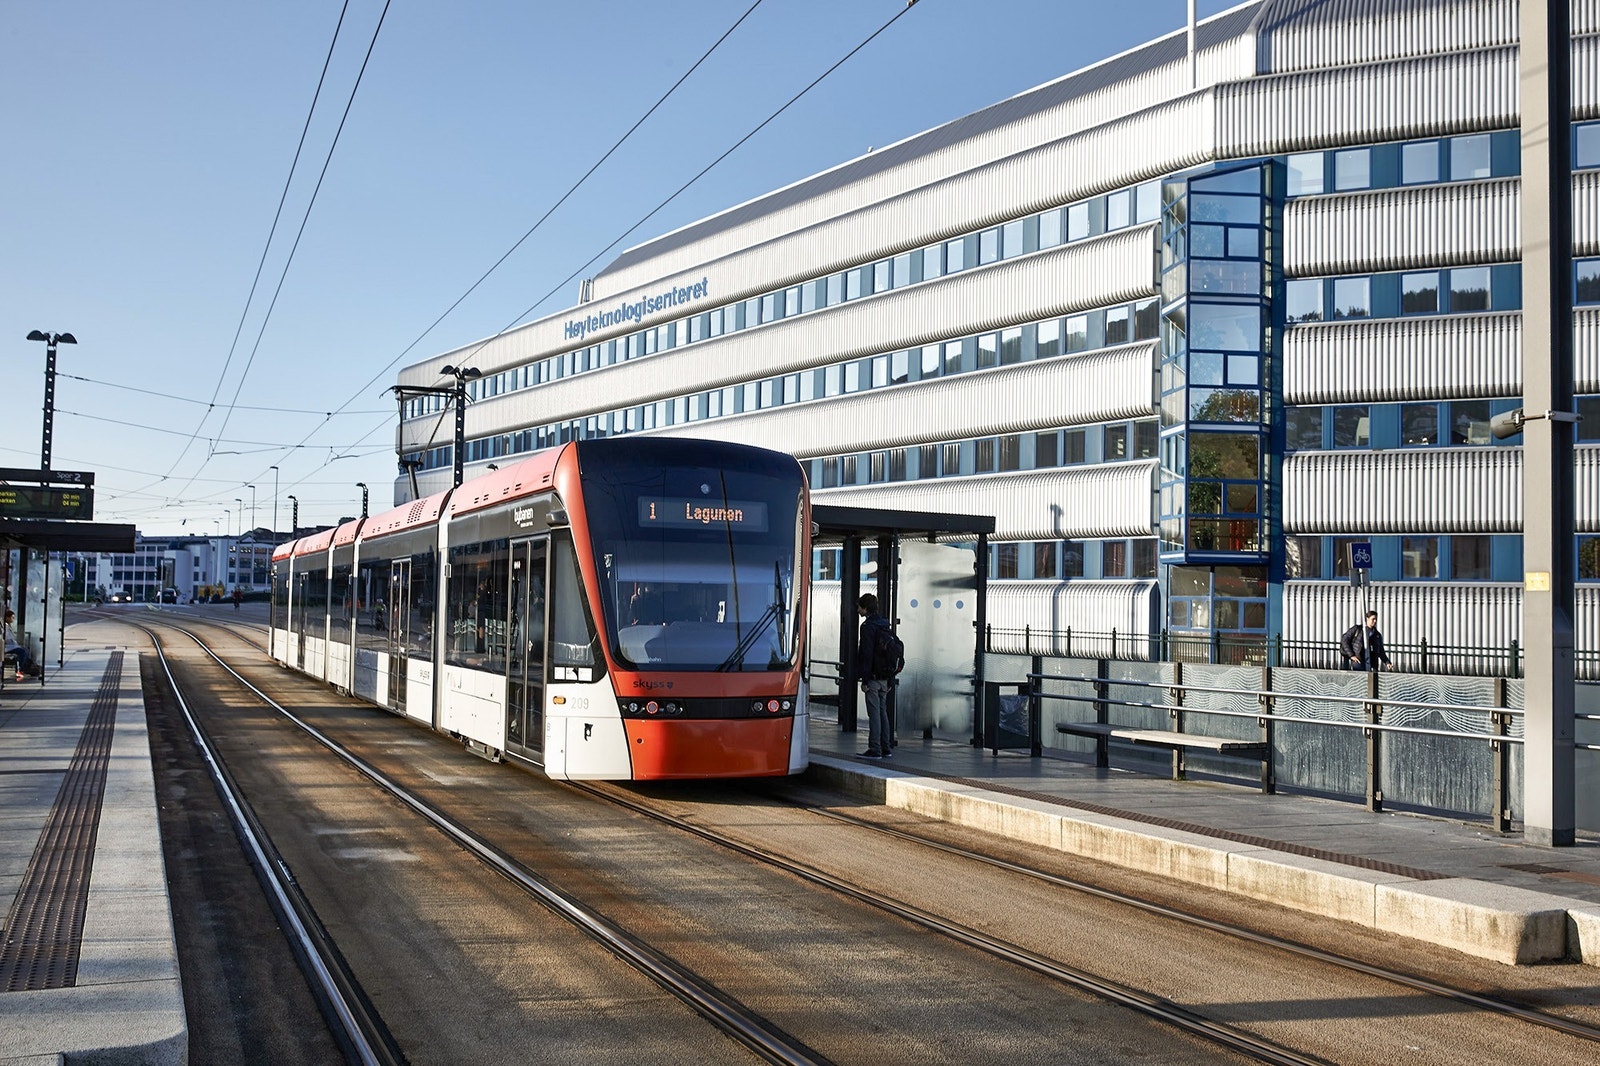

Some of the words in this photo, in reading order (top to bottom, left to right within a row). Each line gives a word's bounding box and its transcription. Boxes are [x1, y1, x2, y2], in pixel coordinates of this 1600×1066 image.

[564, 277, 709, 340] Høyteknologisenteret
[56, 472, 73, 480] Spor
[74, 473, 81, 482] 2
[514, 507, 534, 525] bybanen
[649, 502, 656, 519] 1
[686, 502, 743, 524] Lagunen
[632, 678, 665, 690] skyss
[570, 696, 590, 710] 209
